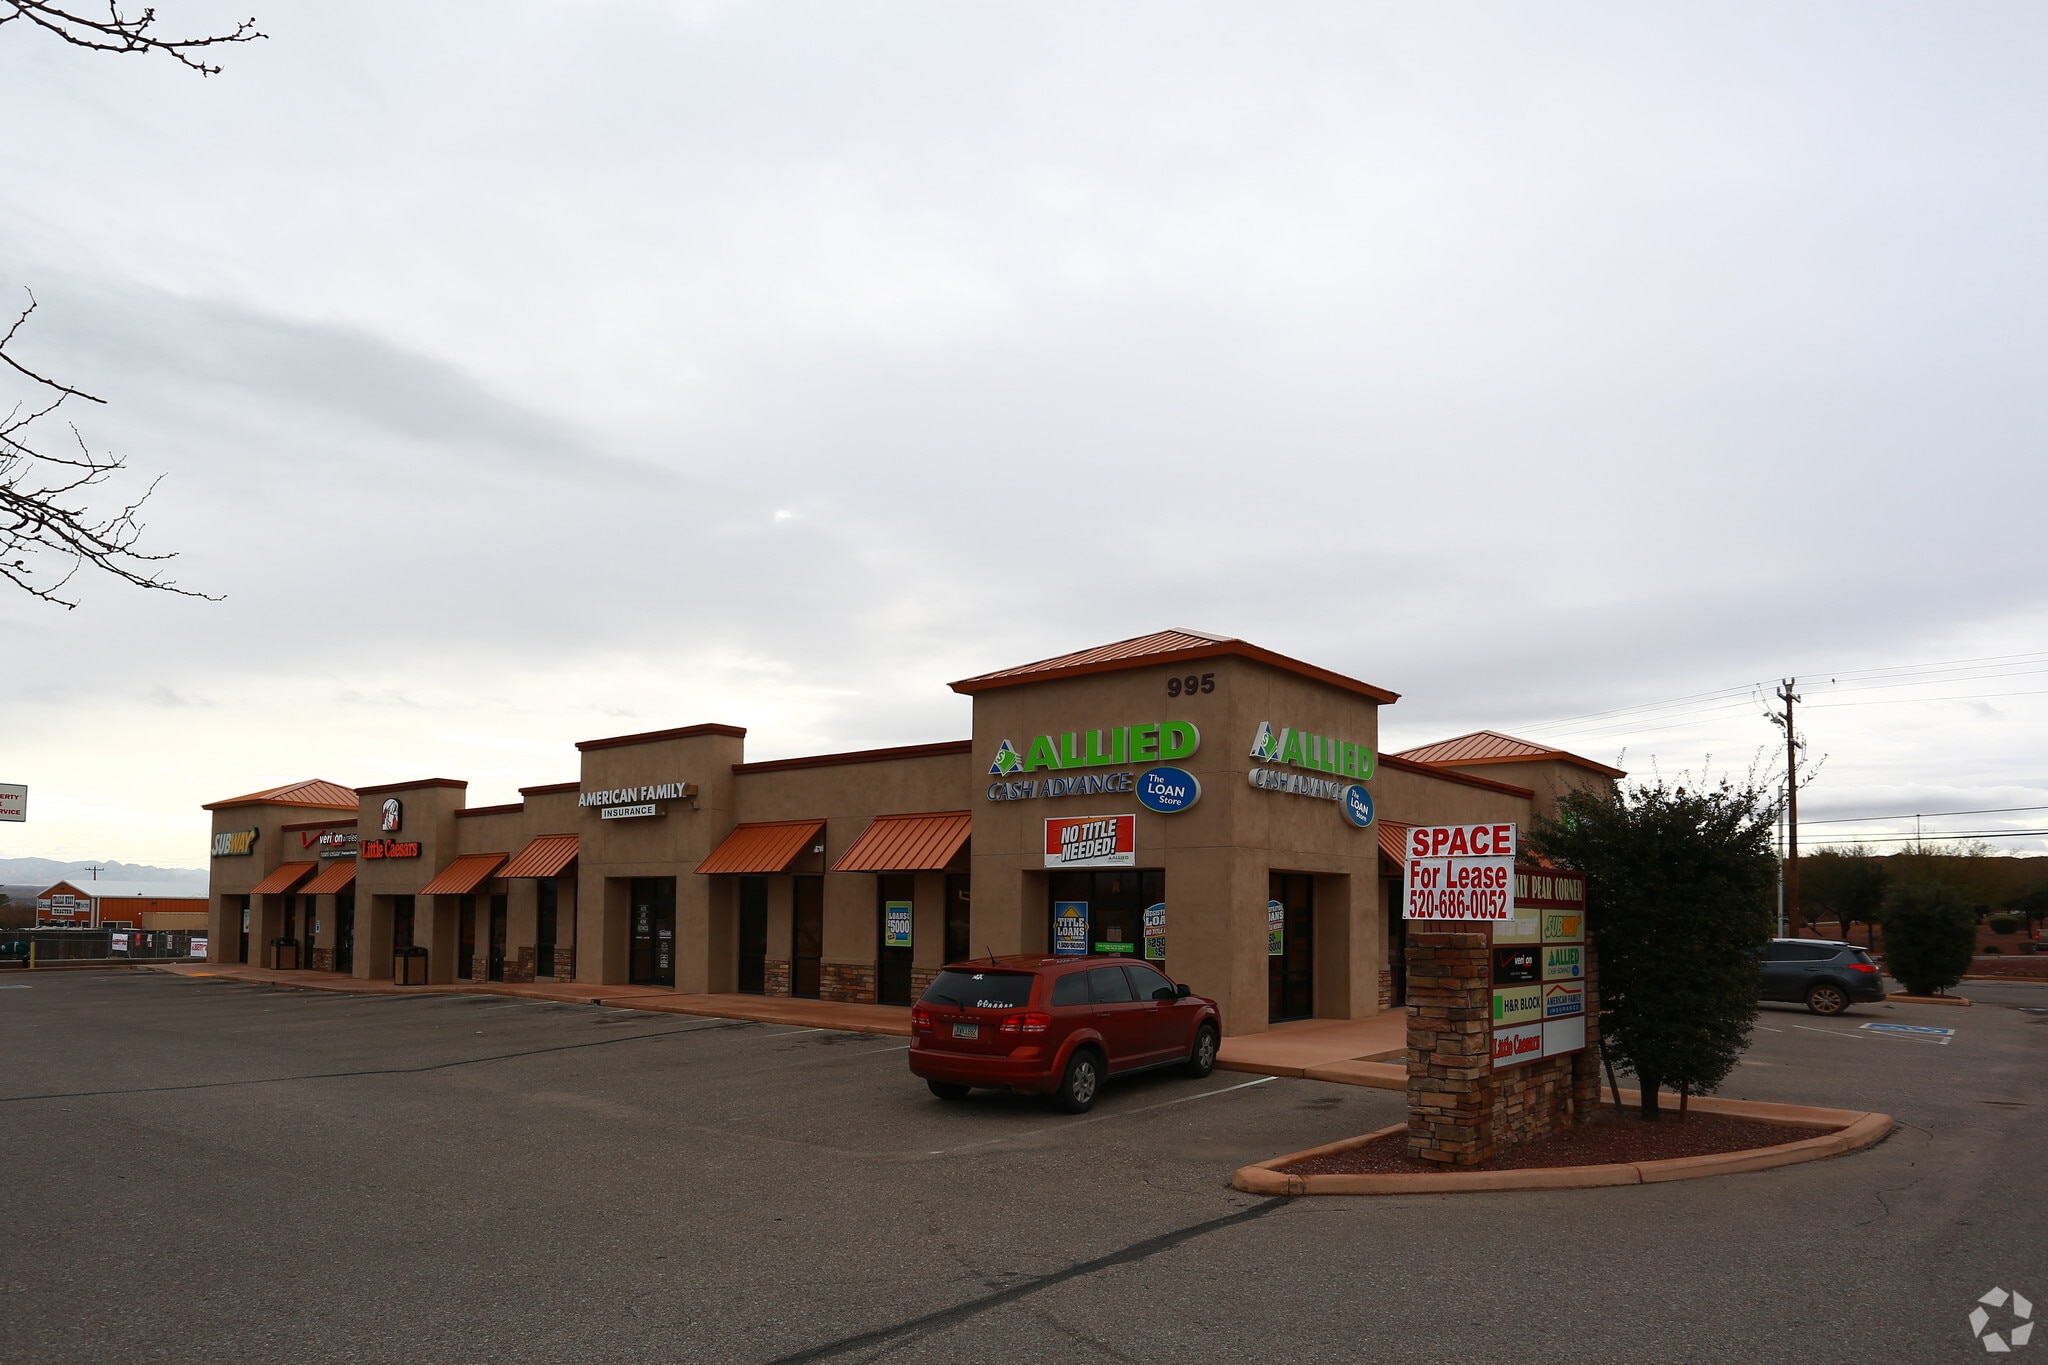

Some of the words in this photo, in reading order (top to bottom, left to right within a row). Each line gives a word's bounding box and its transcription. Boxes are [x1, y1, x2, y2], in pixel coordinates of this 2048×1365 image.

[1167, 672, 1216, 697] 995
[1022, 720, 1200, 773] ALLIED
[1279, 727, 1375, 781] ALLIED
[987, 779, 1038, 801] CASH
[1040, 772, 1135, 798] ADVANCE
[1148, 773, 1165, 784] The
[1254, 768, 1289, 791] CASH
[1293, 774, 1344, 801] ADVANCE
[578, 787, 638, 807] AMERICAN
[641, 782, 686, 801] FAMILY
[1147, 782, 1186, 798] LOAN
[1351, 789, 1361, 799] The
[1158, 795, 1182, 806] Store
[1350, 799, 1369, 815] LOAN
[604, 806, 653, 817] INSURANCE
[1355, 810, 1367, 822] Store
[320, 832, 343, 846] verizon
[1061, 825, 1080, 844] NO
[1081, 819, 1117, 840] TITLE
[211, 830, 257, 856] SUBWAY
[361, 839, 384, 858] Little
[385, 838, 418, 857] Caesars
[1061, 836, 1117, 861] NEEDED!
[1412, 825, 1511, 857] SPACE
[1410, 860, 1440, 888] For
[1446, 860, 1507, 889] Lease
[1531, 875, 1552, 899] PEAR
[1554, 877, 1583, 901] CORNER
[1409, 889, 1507, 919] 520-686-0052
[889, 912, 906, 920] LOANS
[1057, 917, 1085, 927] TITLE
[888, 920, 910, 933] $5000
[1057, 927, 1085, 936] LOANS
[1544, 914, 1582, 938] SUBWAY
[1514, 955, 1533, 967] verizon
[1555, 948, 1579, 965] ALLIED
[1504, 999, 1519, 1012] H&R
[1520, 996, 1541, 1010] BLOCK
[1547, 995, 1567, 1006] AMERICAN
[1549, 1005, 1579, 1014] INSURANCE
[1493, 1036, 1513, 1059] Little
